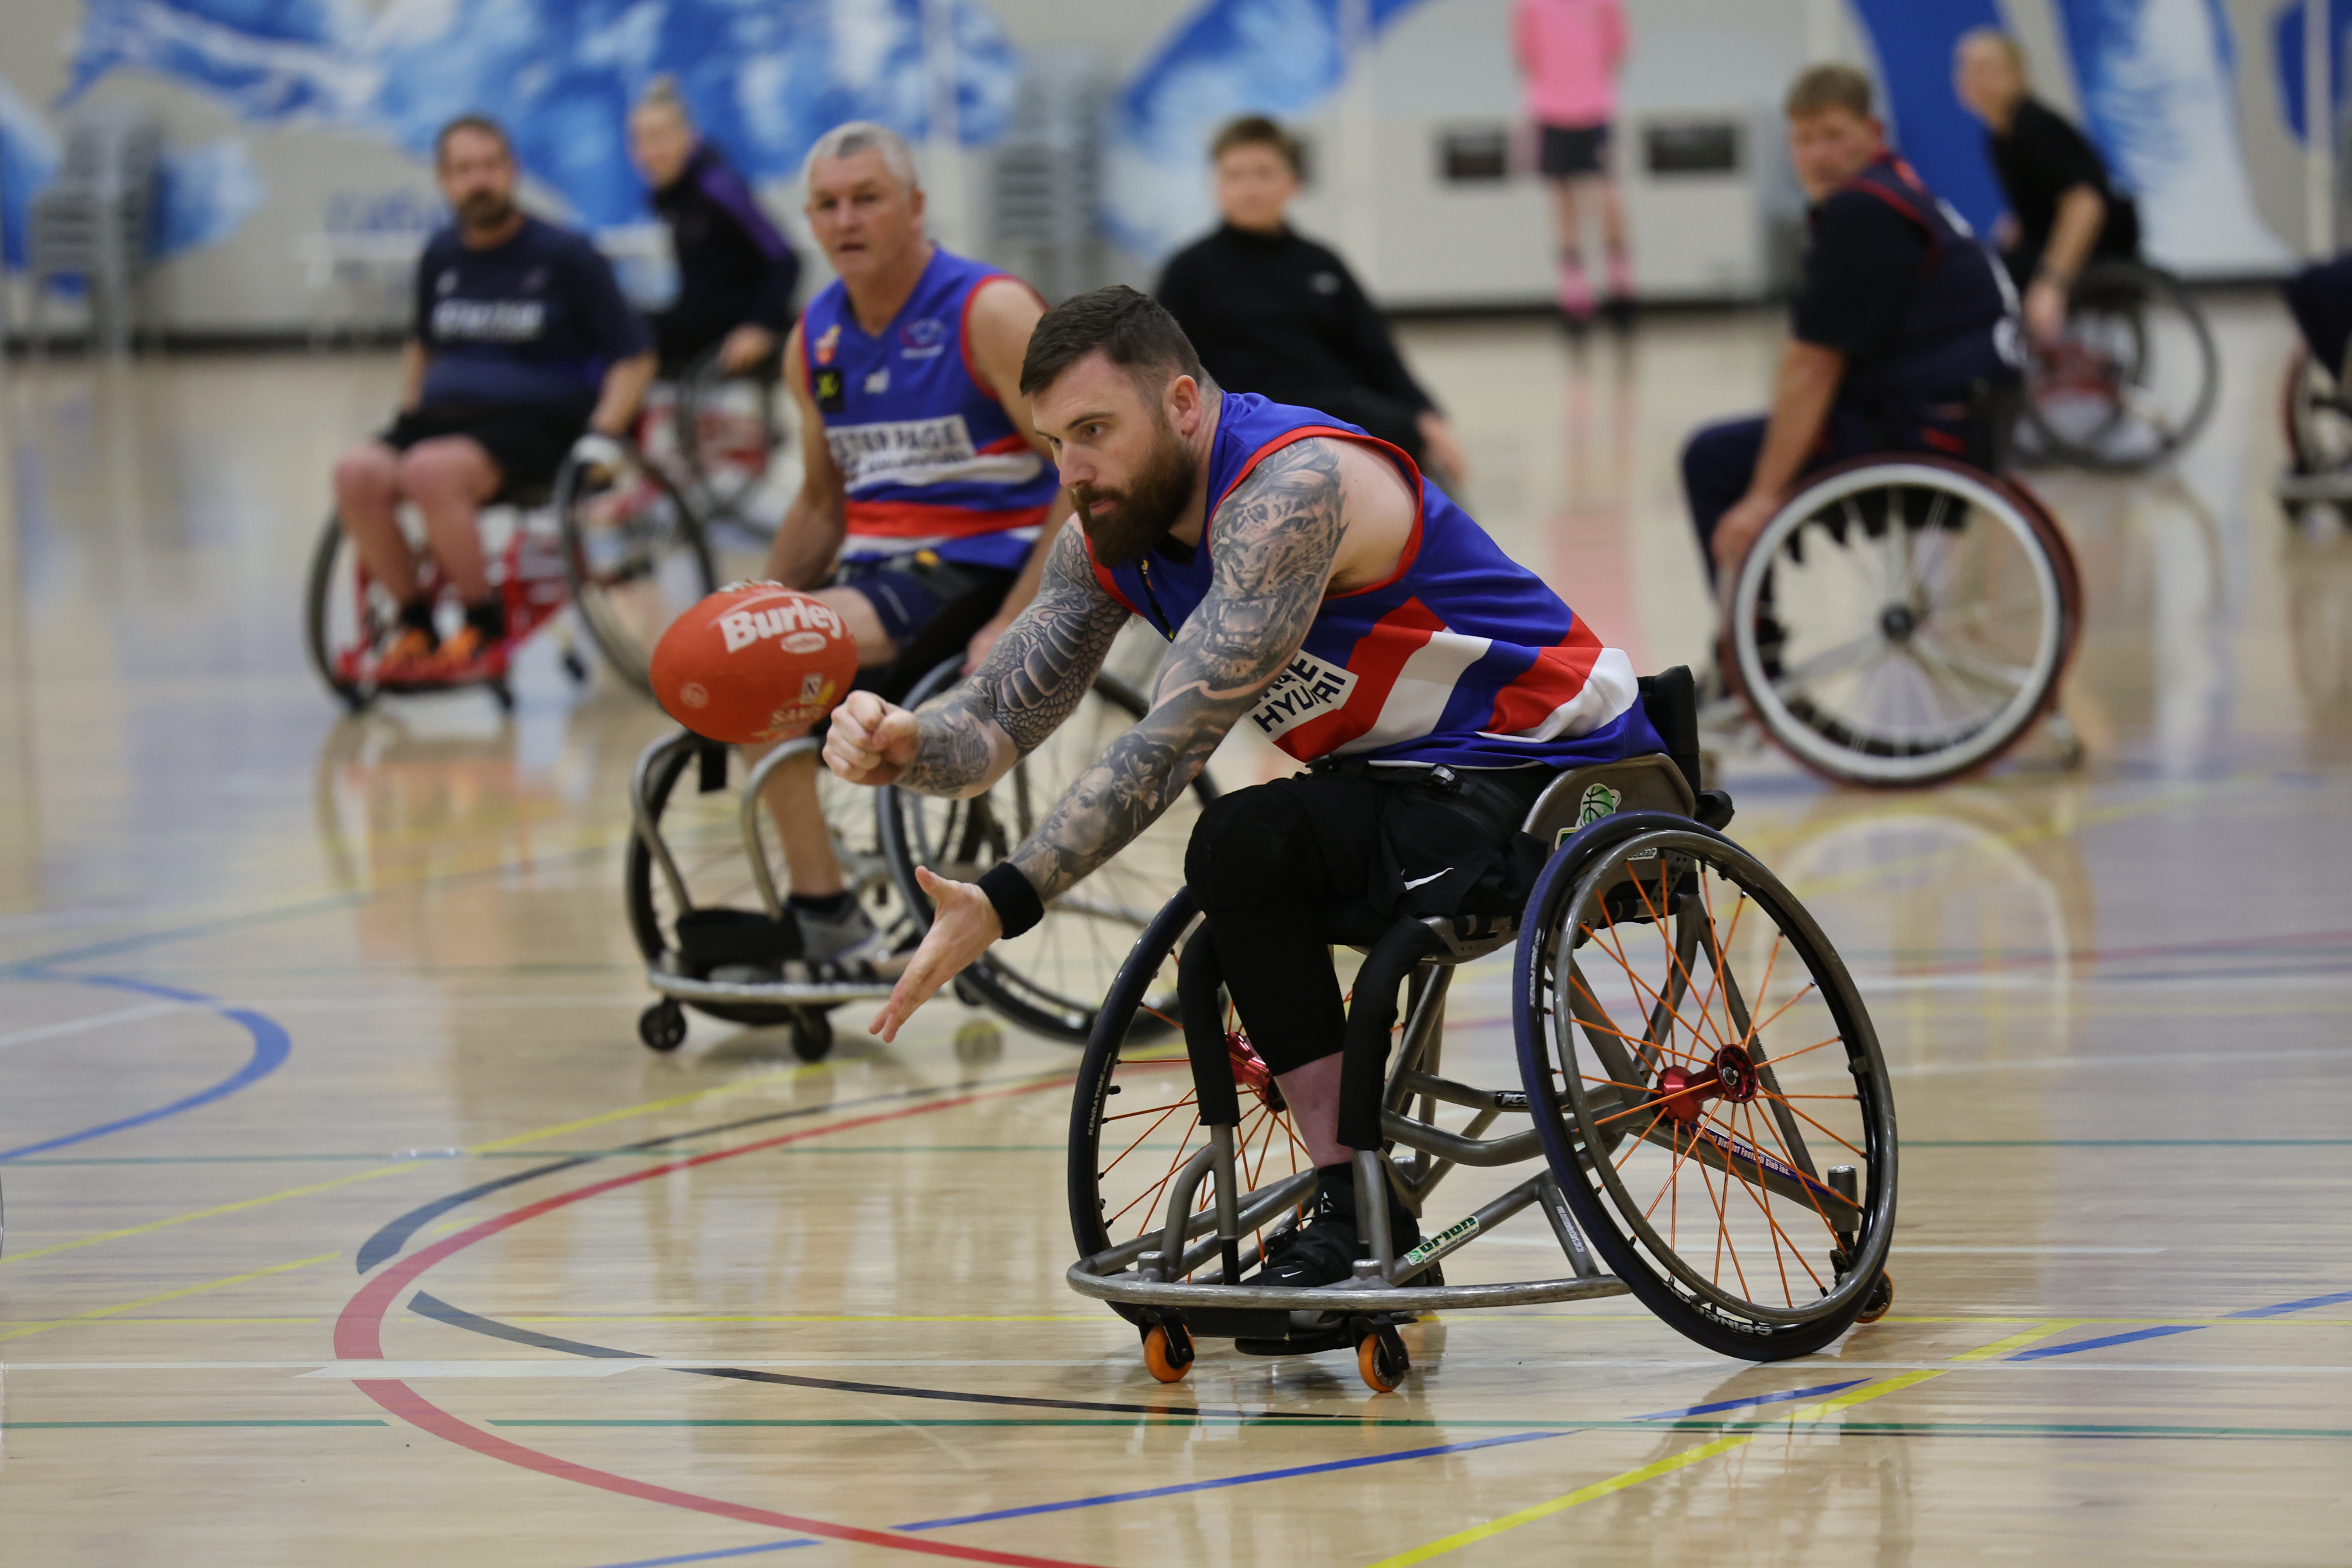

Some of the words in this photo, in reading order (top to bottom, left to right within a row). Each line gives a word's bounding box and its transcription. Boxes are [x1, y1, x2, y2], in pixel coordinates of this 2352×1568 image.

[720, 597, 842, 653] Burley
[1252, 671, 1346, 733] HYUAI
[1717, 1136, 1740, 1153] Distict
[1741, 1146, 1764, 1164] Footbll
[1419, 1217, 1477, 1253] orion
